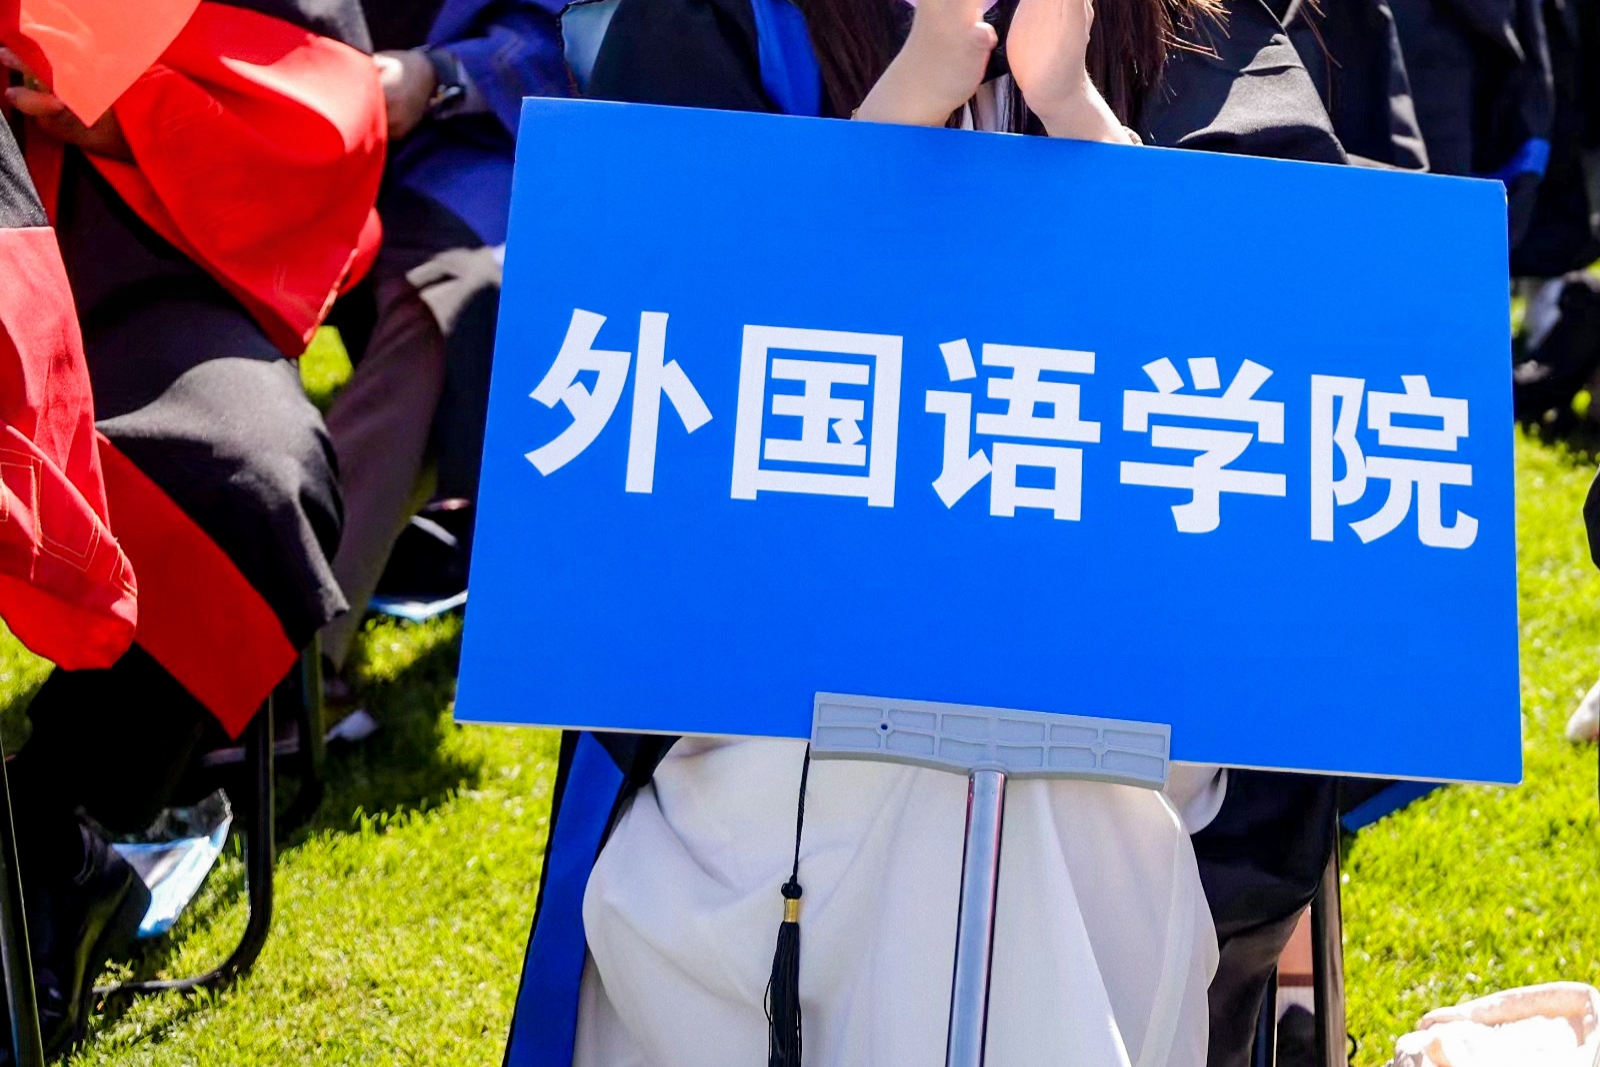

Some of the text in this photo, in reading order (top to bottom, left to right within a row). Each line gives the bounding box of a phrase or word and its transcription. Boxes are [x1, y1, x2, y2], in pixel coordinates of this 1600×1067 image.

[524, 308, 1479, 549] 外国语学院
